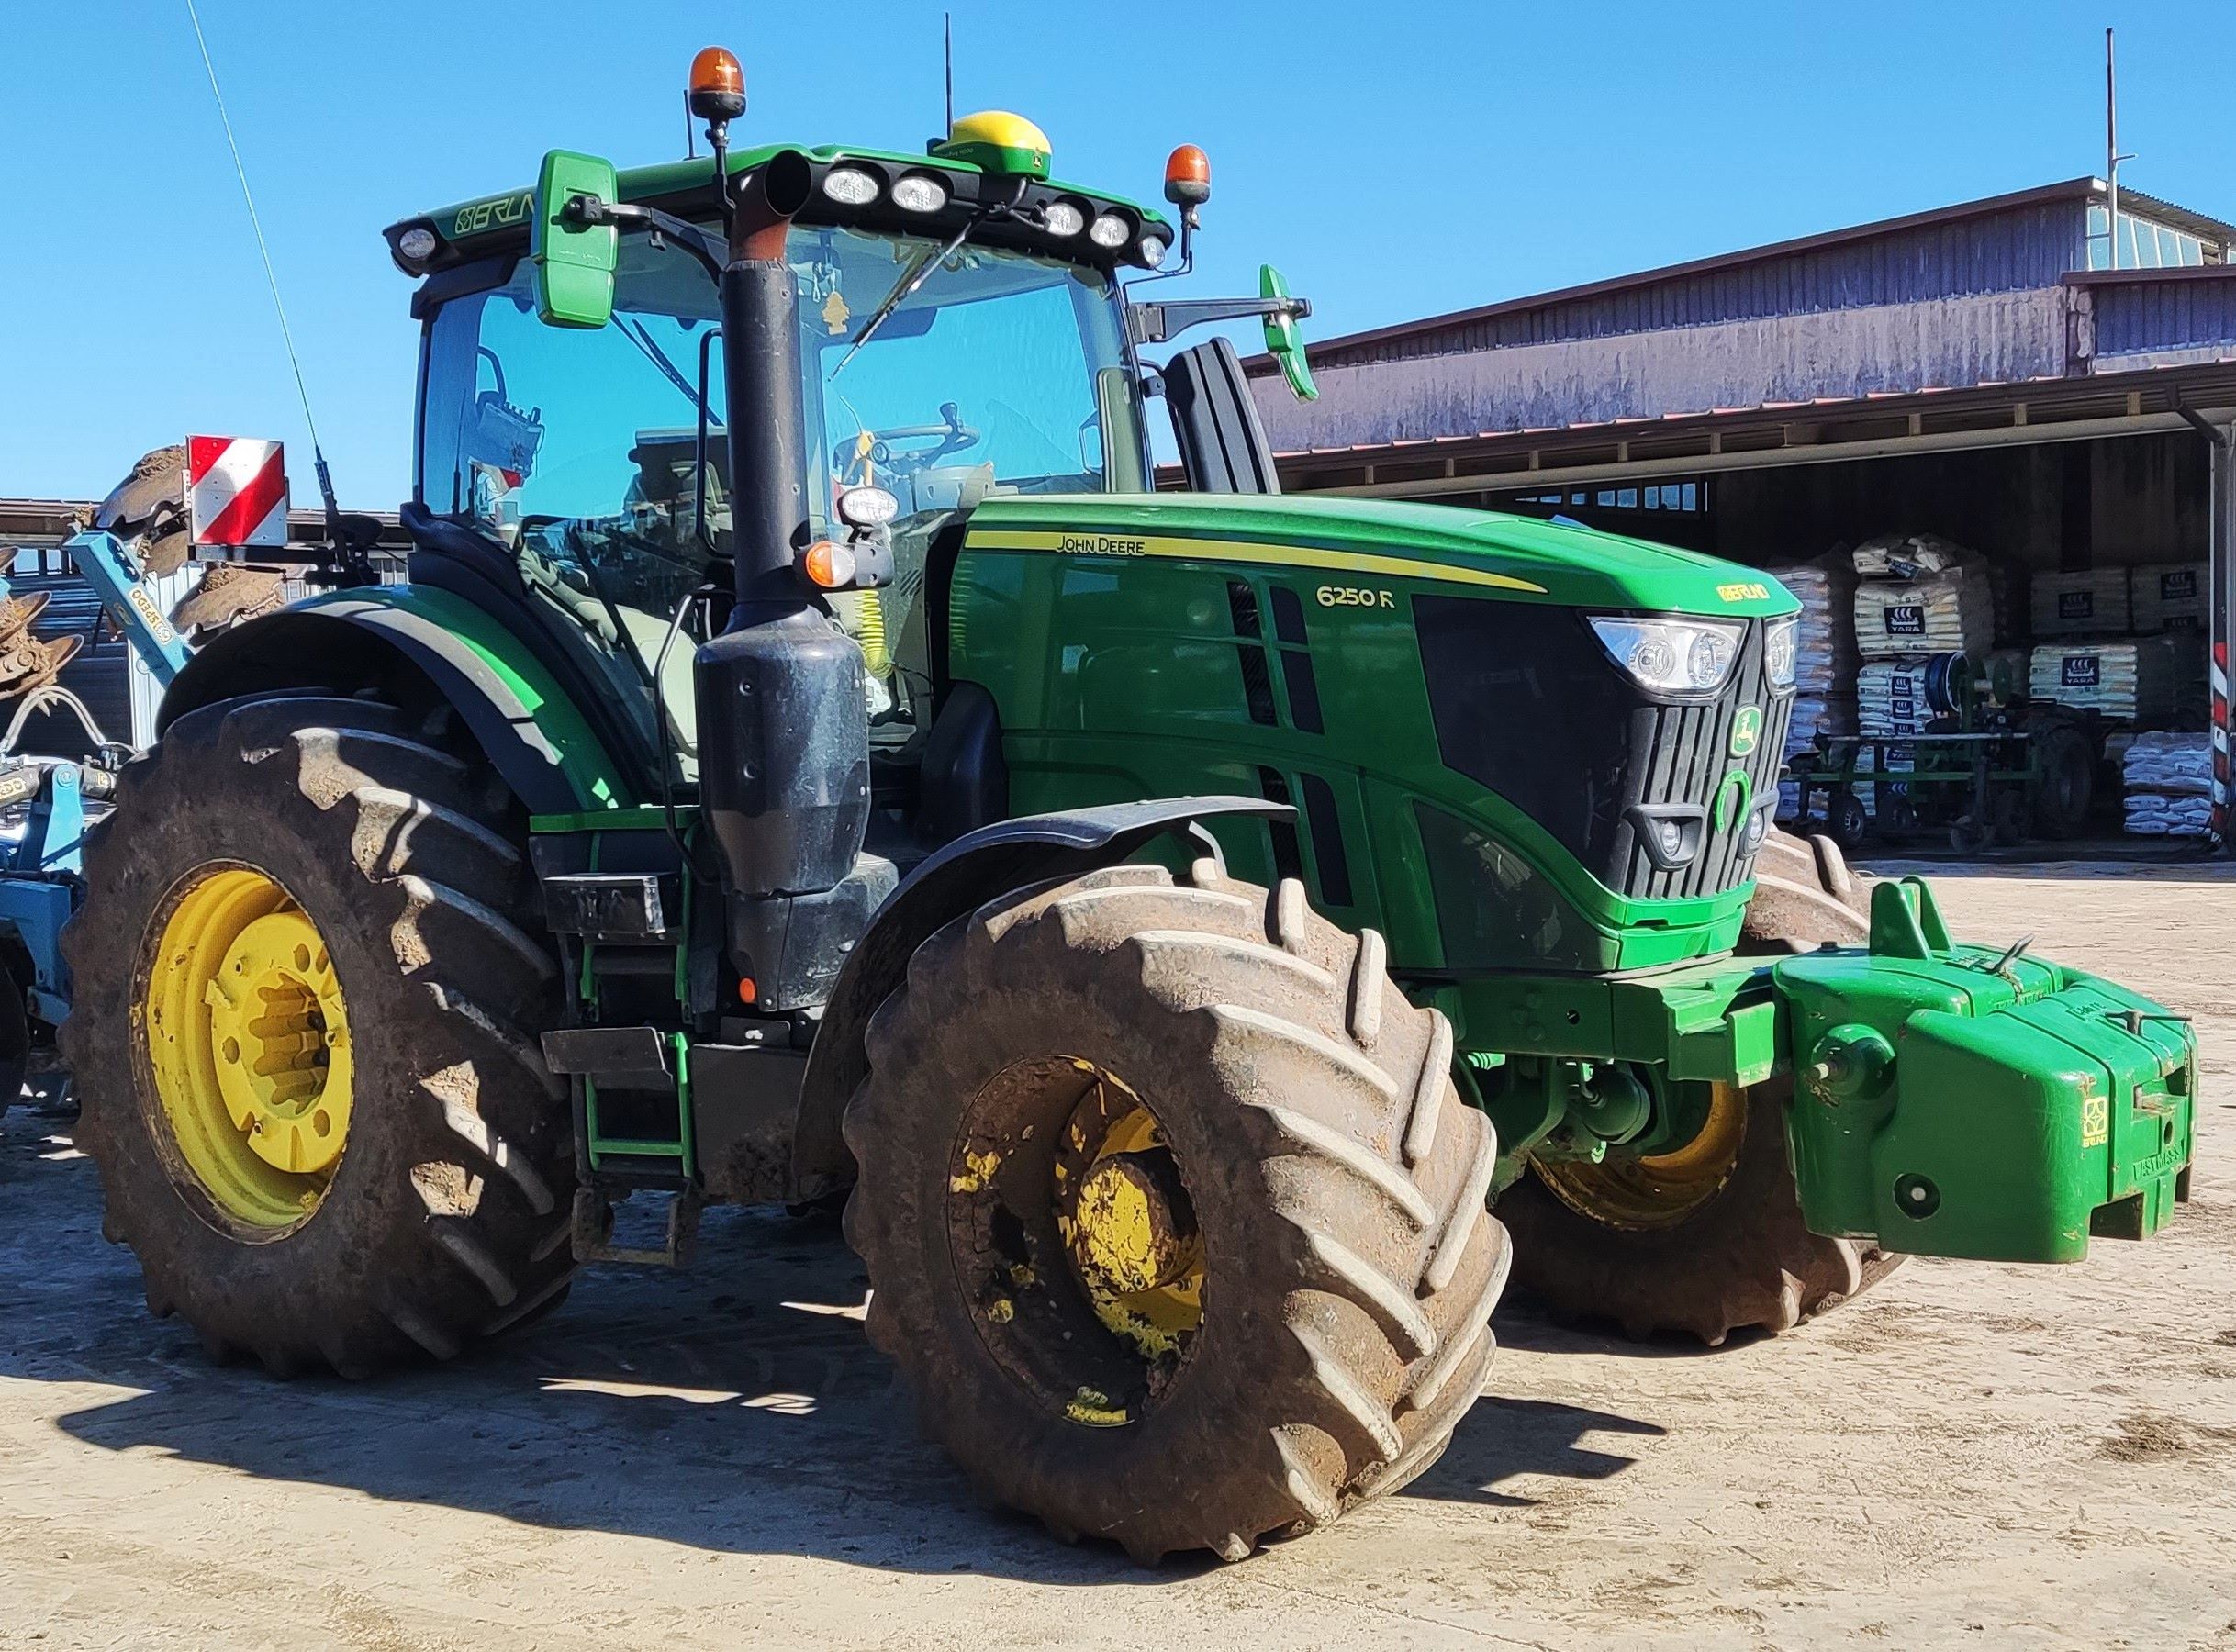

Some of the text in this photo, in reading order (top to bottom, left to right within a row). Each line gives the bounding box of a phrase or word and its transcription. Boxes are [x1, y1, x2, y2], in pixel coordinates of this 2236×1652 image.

[1057, 535, 1146, 554] JOHN DEERE
[131, 589, 160, 624] SPEDO
[1316, 586, 1395, 608] 6250 R
